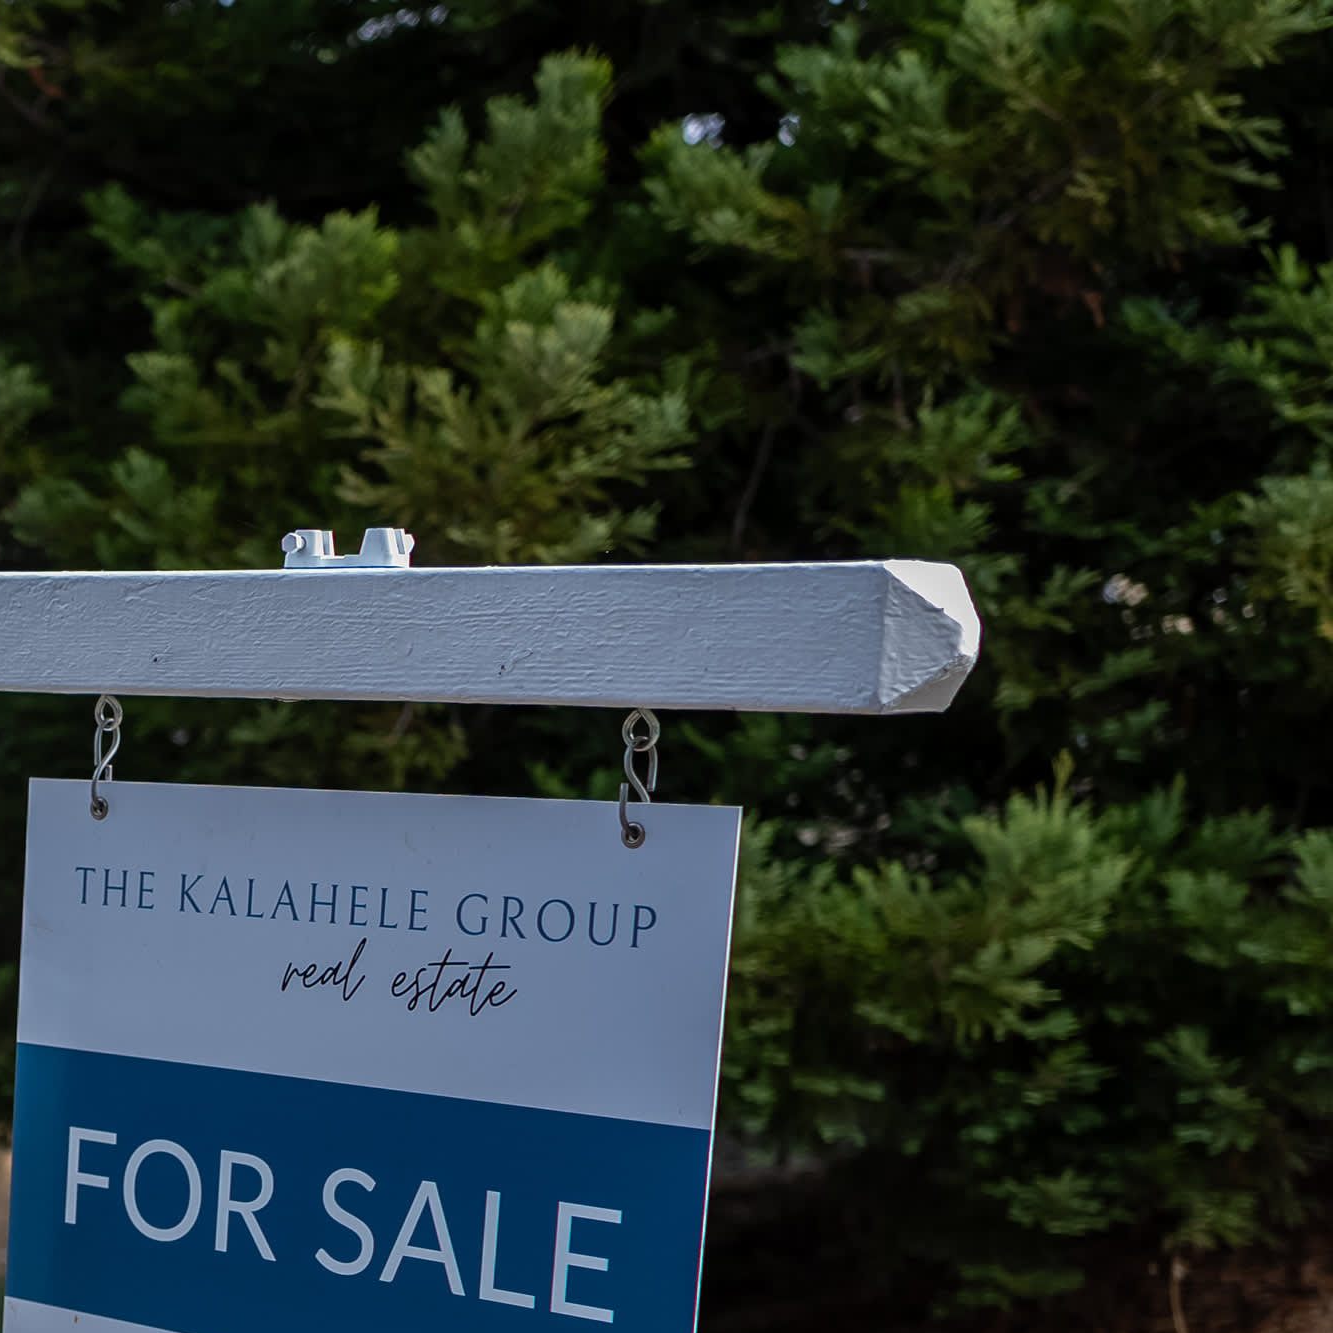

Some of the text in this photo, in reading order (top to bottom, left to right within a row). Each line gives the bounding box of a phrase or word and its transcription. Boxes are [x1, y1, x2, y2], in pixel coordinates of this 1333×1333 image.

[75, 866, 659, 949] THE KALAHELE GROUP
[280, 937, 518, 1017] real estate
[64, 1126, 622, 1323] FOR SALE
